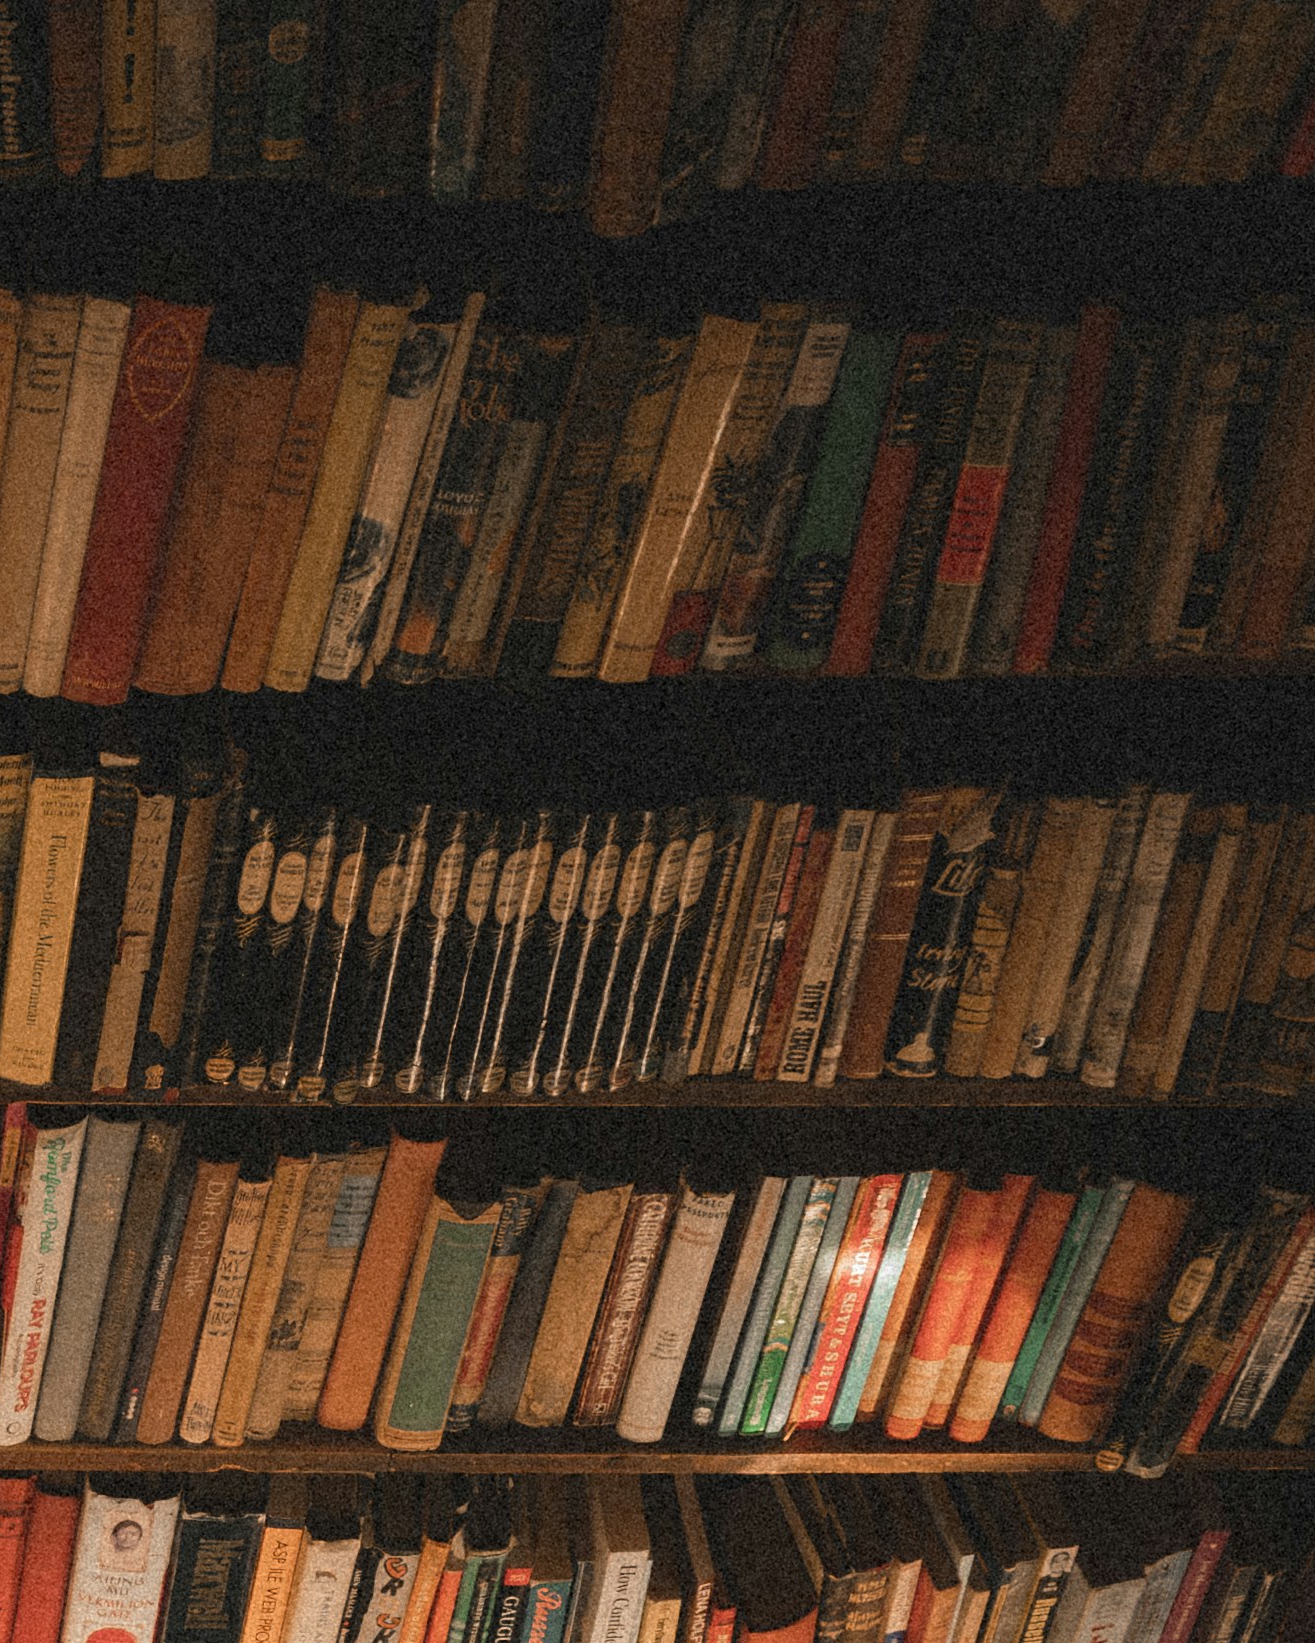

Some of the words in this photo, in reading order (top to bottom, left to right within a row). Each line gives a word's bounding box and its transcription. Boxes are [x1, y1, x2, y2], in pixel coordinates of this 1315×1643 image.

[794, 977, 826, 1023] HAUL
[783, 1025, 814, 1075] ROME
[616, 1552, 644, 1585] How
